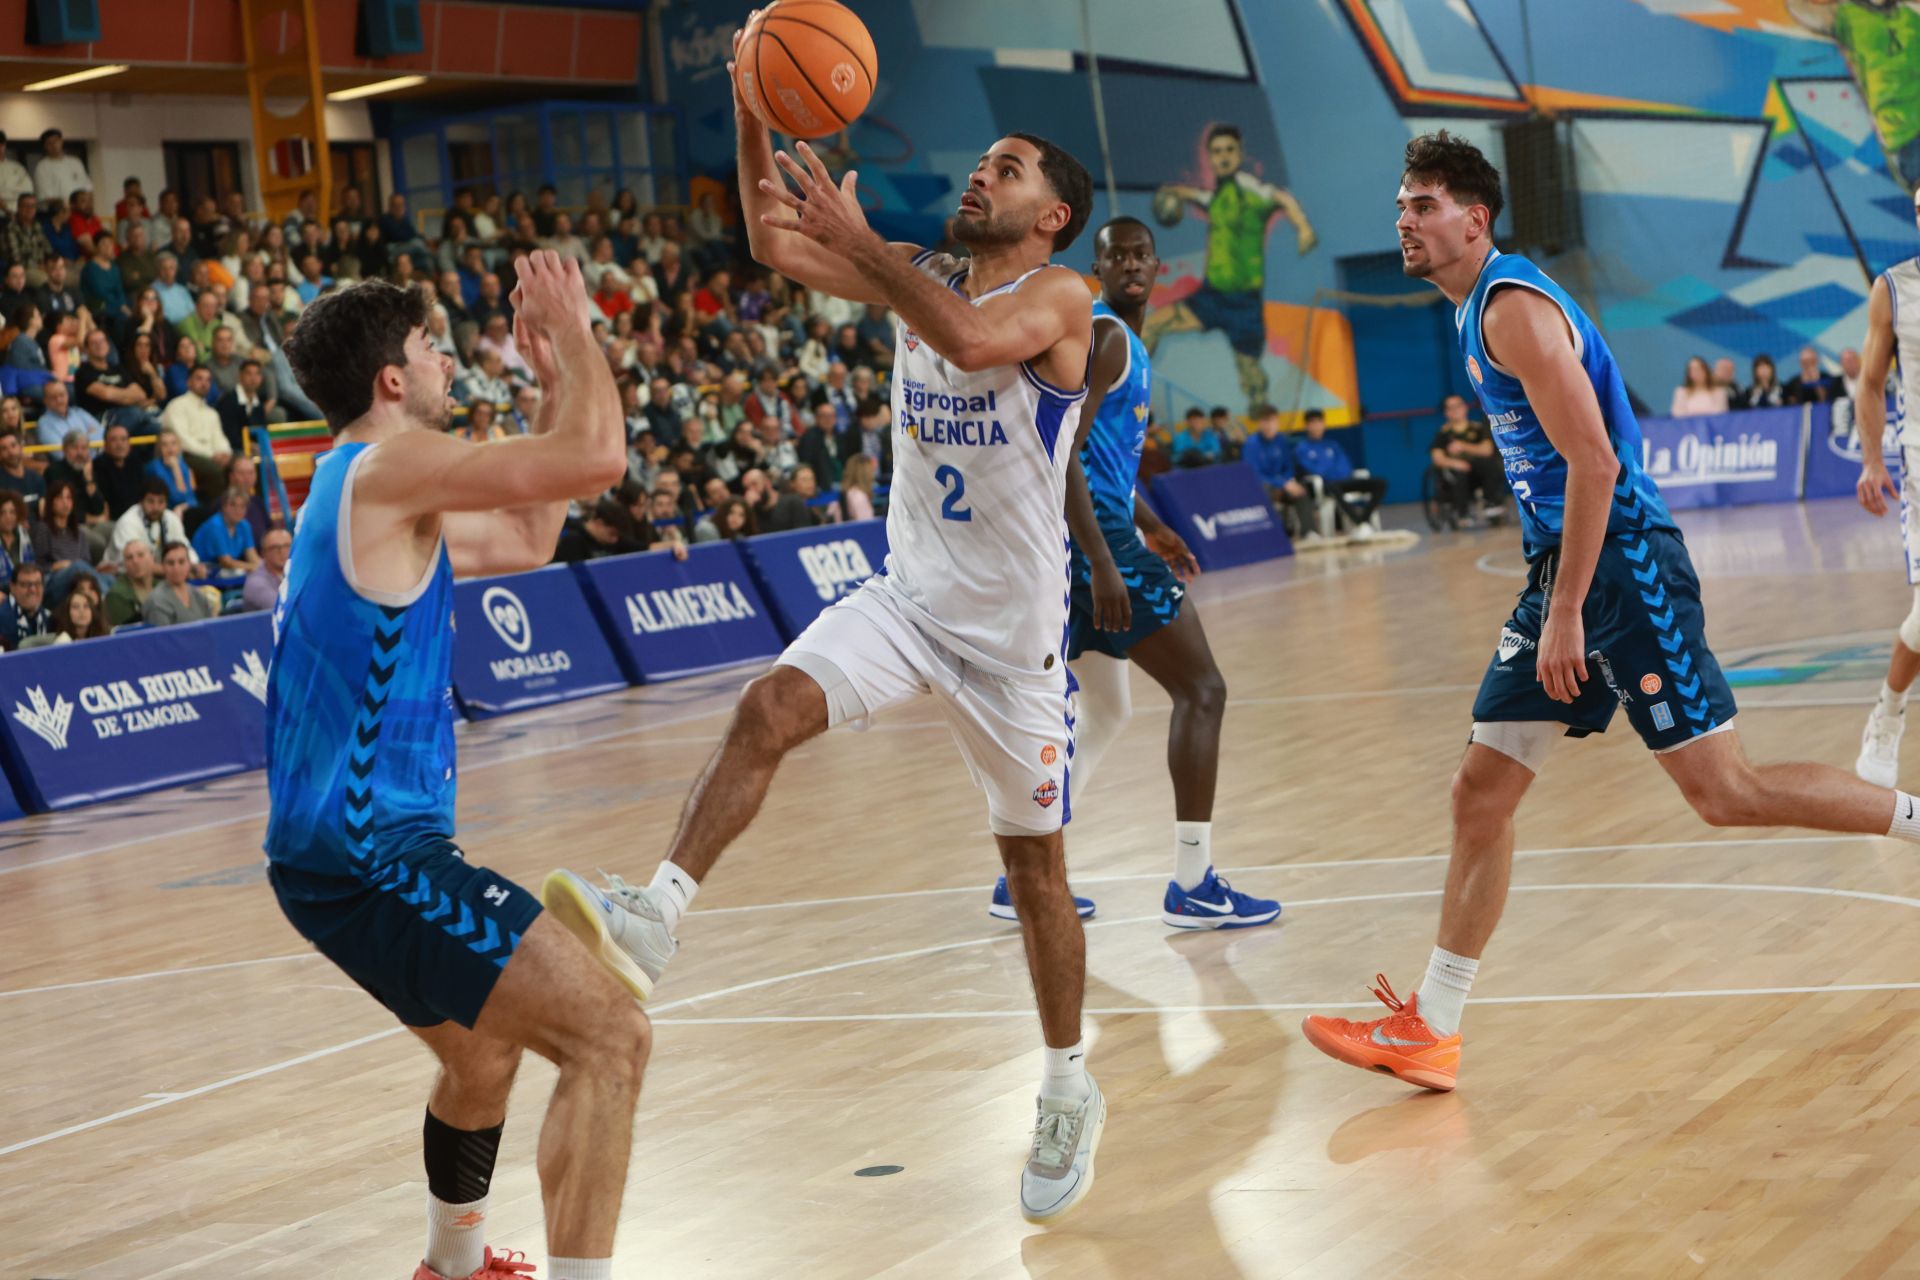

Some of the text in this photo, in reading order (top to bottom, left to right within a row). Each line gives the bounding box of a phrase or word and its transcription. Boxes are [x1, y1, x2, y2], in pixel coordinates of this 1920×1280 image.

[903, 388, 997, 416] agropal
[1677, 432, 1778, 480] Opinión
[934, 464, 972, 522] 2
[798, 538, 873, 601] gaza
[625, 581, 756, 635] ALIMERKA
[490, 650, 572, 681] MORALEJO
[79, 666, 224, 714] CAJA RURAL
[92, 702, 200, 739] DE ZAMORA
